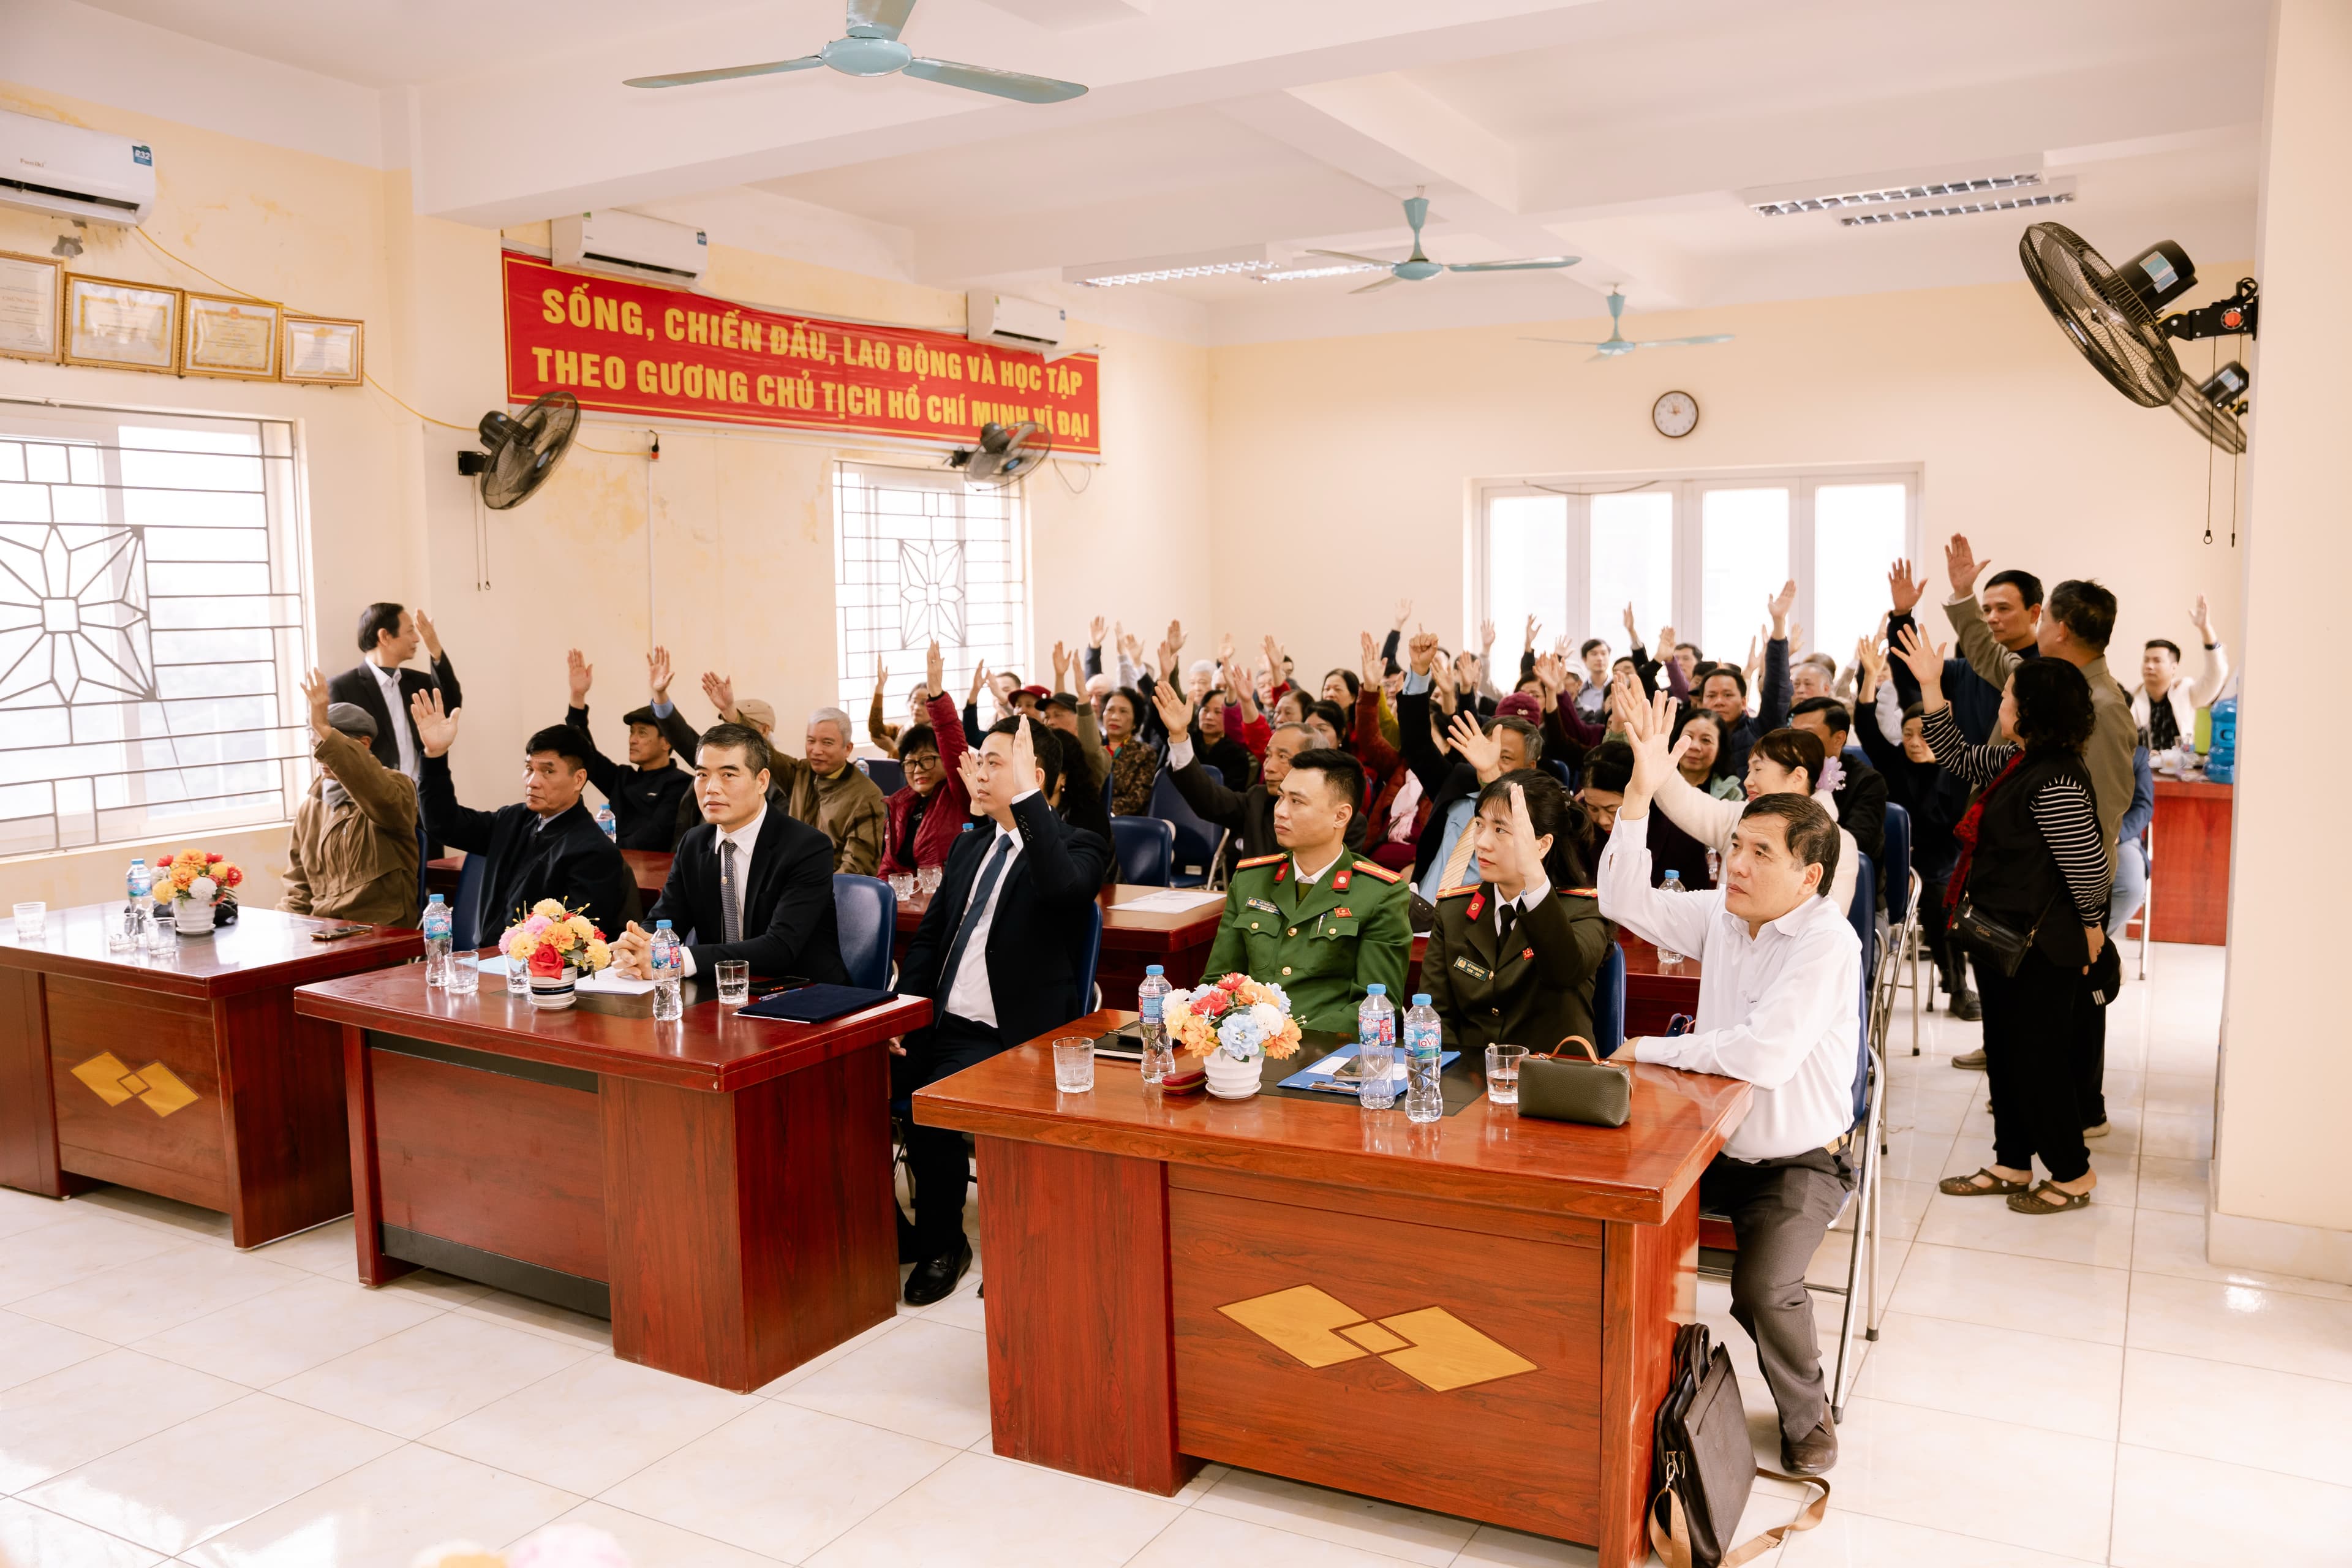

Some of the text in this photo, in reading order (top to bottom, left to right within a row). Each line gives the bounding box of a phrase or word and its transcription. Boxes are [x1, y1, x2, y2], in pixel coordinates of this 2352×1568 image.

[543, 283, 1083, 400] SỐNG, CHIẾN ĐẤU, LAO ĐỘNG VÀ HỌC TẬP
[532, 346, 1090, 443] THEO GƯƠNG CHỦ TỊCH HỒ CHÍ MINH VĨ ĐẠI
[1417, 1037, 1439, 1047] laVie
